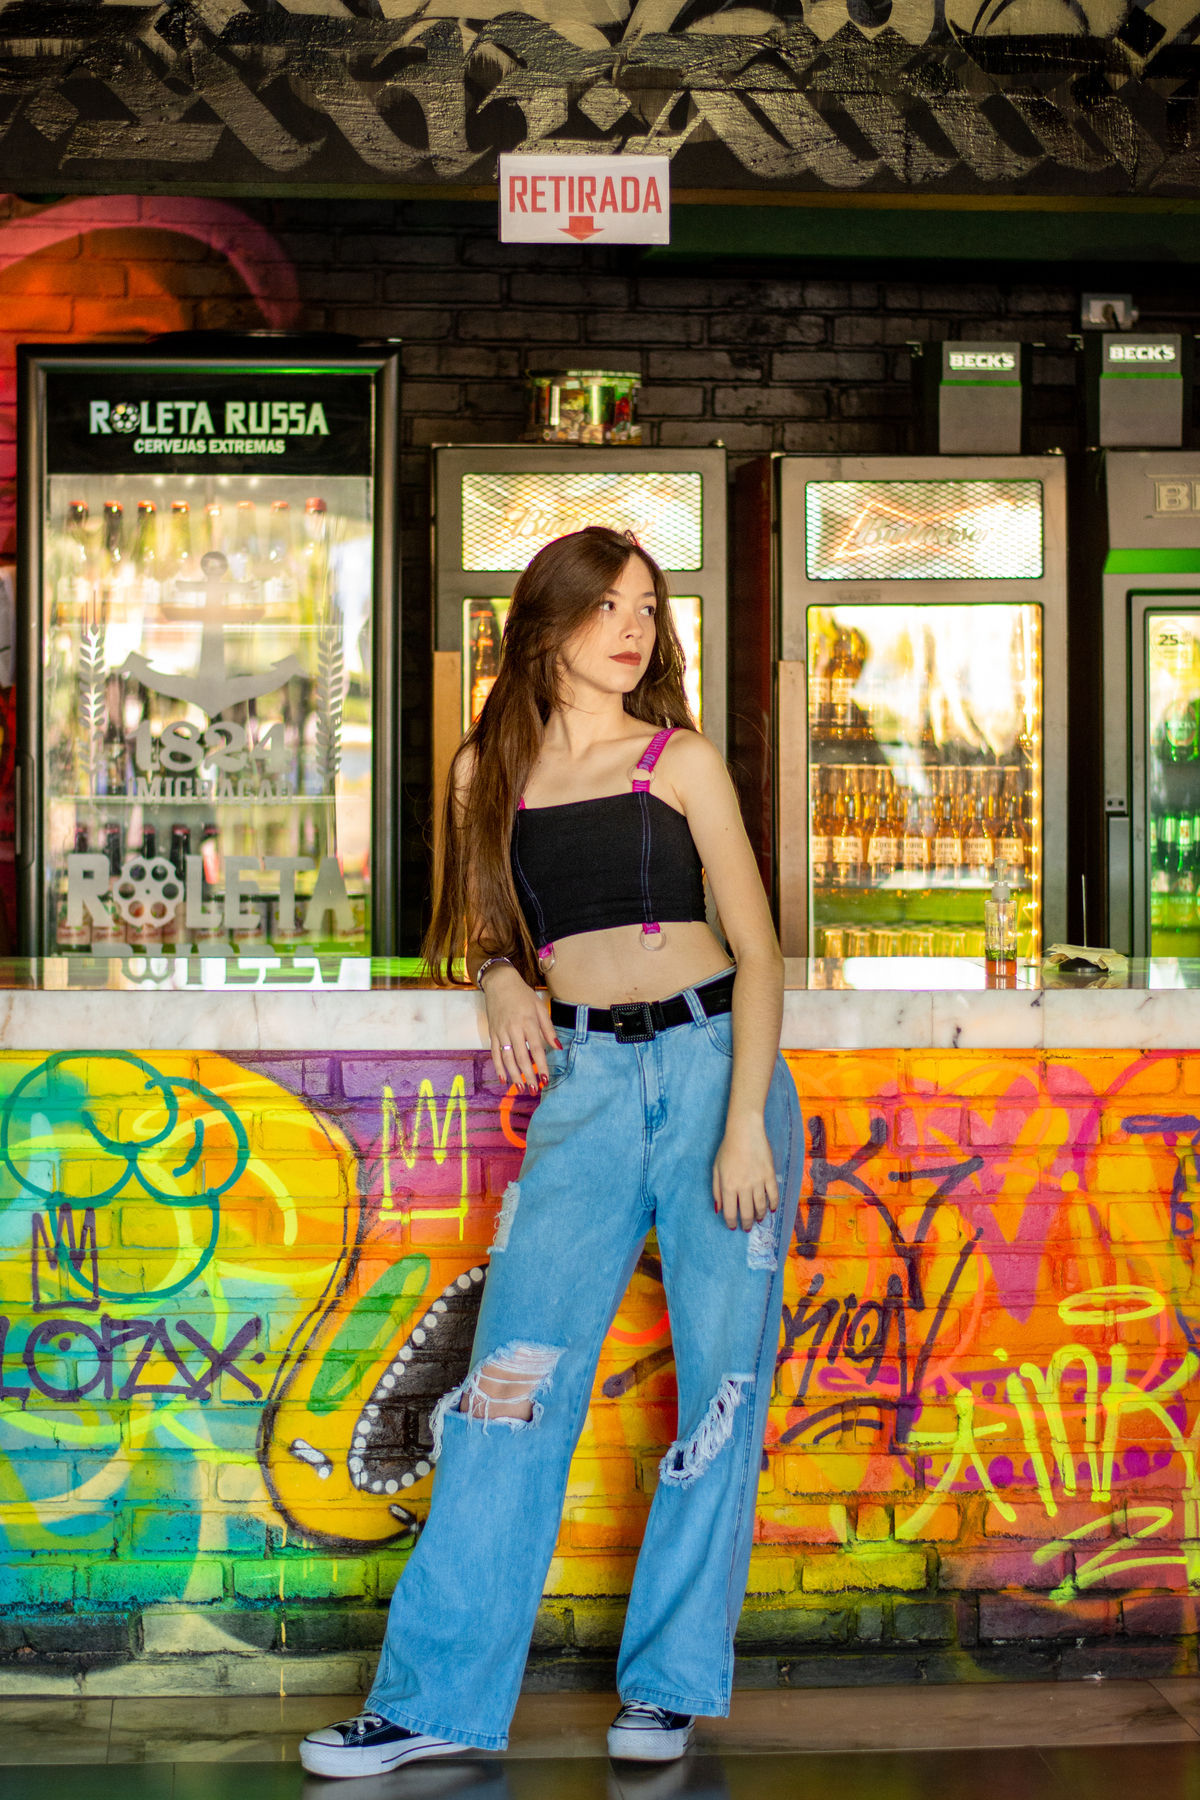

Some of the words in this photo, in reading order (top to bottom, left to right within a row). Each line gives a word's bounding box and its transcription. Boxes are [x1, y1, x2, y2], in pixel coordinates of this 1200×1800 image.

[509, 176, 662, 213] RETIRADA
[950, 353, 1015, 369] BECK'S
[1109, 345, 1176, 361] BECK'S
[225, 402, 330, 435] RUSSA
[134, 438, 207, 454] CERVEJAS
[208, 438, 286, 454] EXTREMAS
[126, 720, 292, 772] 1824
